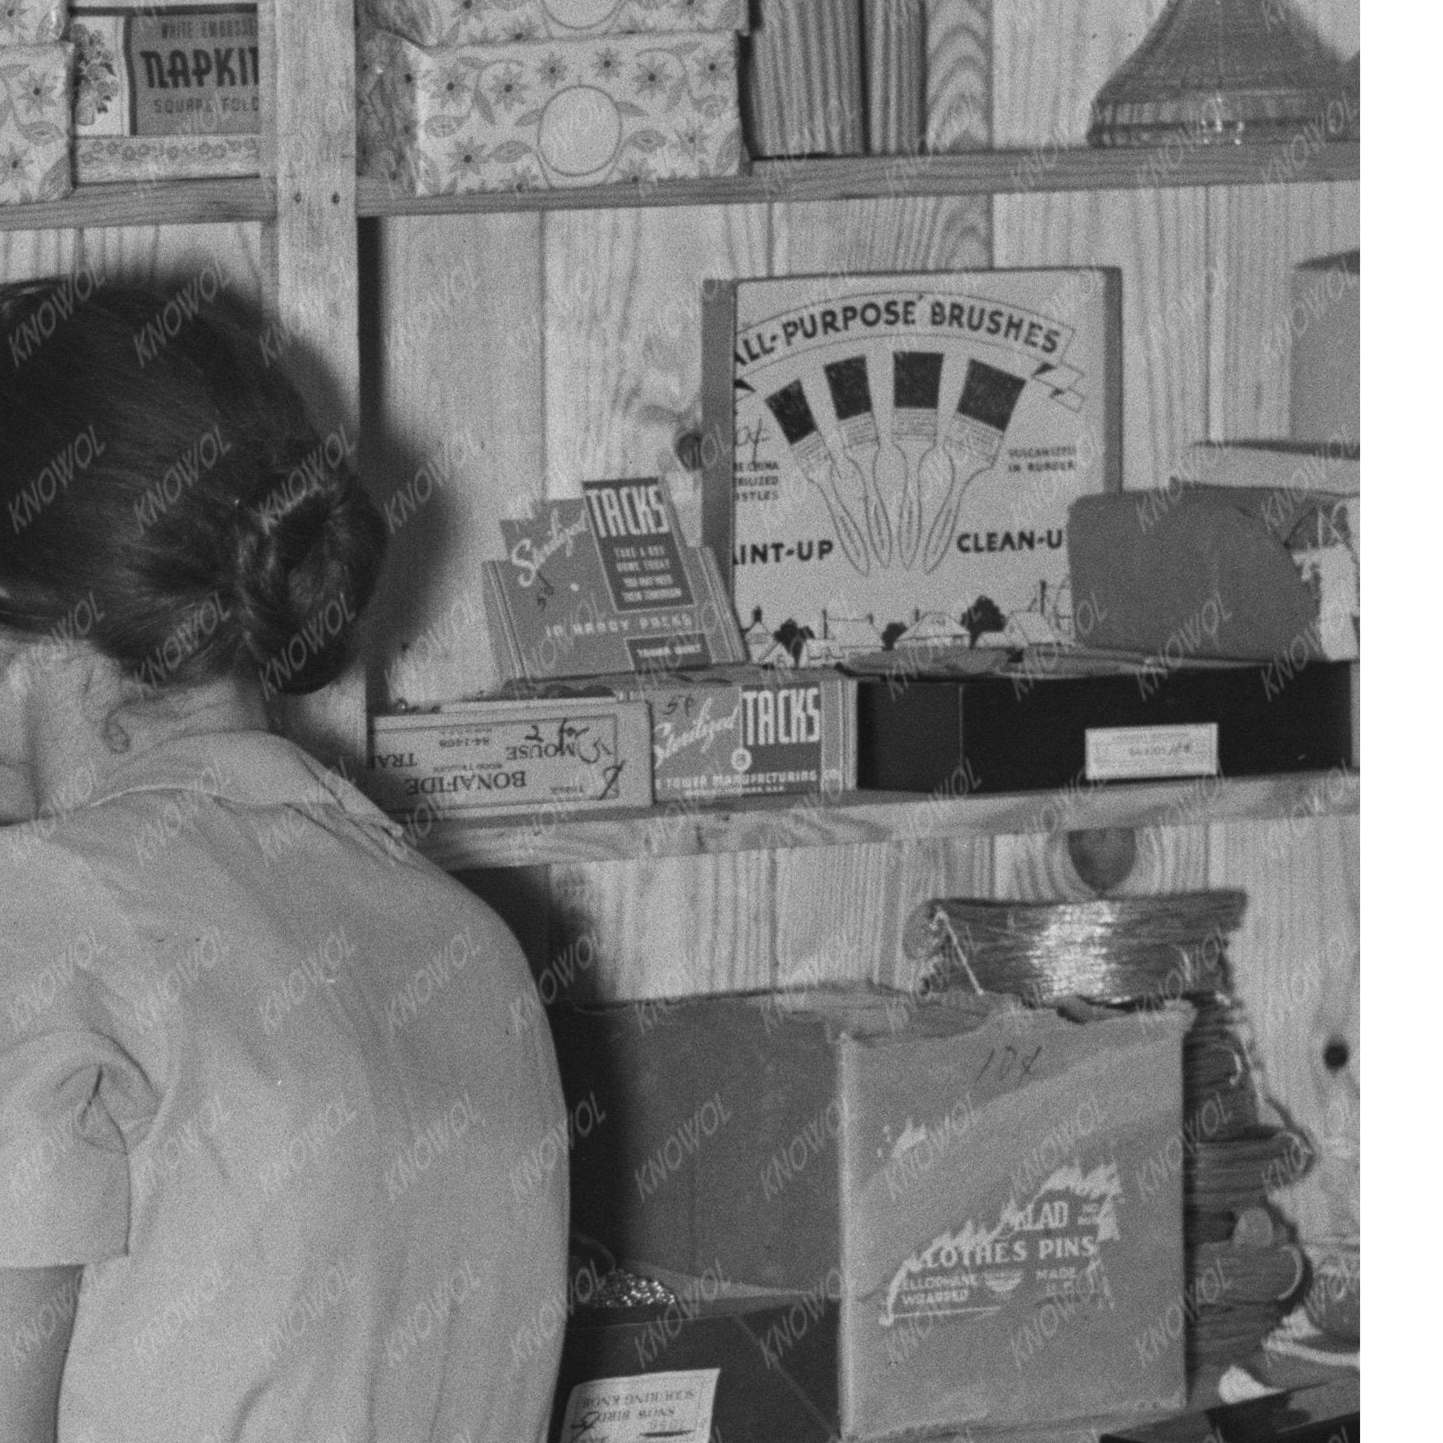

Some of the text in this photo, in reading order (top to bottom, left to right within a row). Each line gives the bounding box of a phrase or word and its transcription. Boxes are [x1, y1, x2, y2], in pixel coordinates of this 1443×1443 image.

[930, 300, 1061, 355] BRUSHES
[585, 484, 671, 538] TACKS
[742, 687, 821, 746] TACKS
[505, 743, 577, 761] MOUSE
[405, 770, 527, 796] BONAFIDE
[713, 769, 818, 787] MANUFACTURING
[1038, 1237, 1096, 1259] PINS
